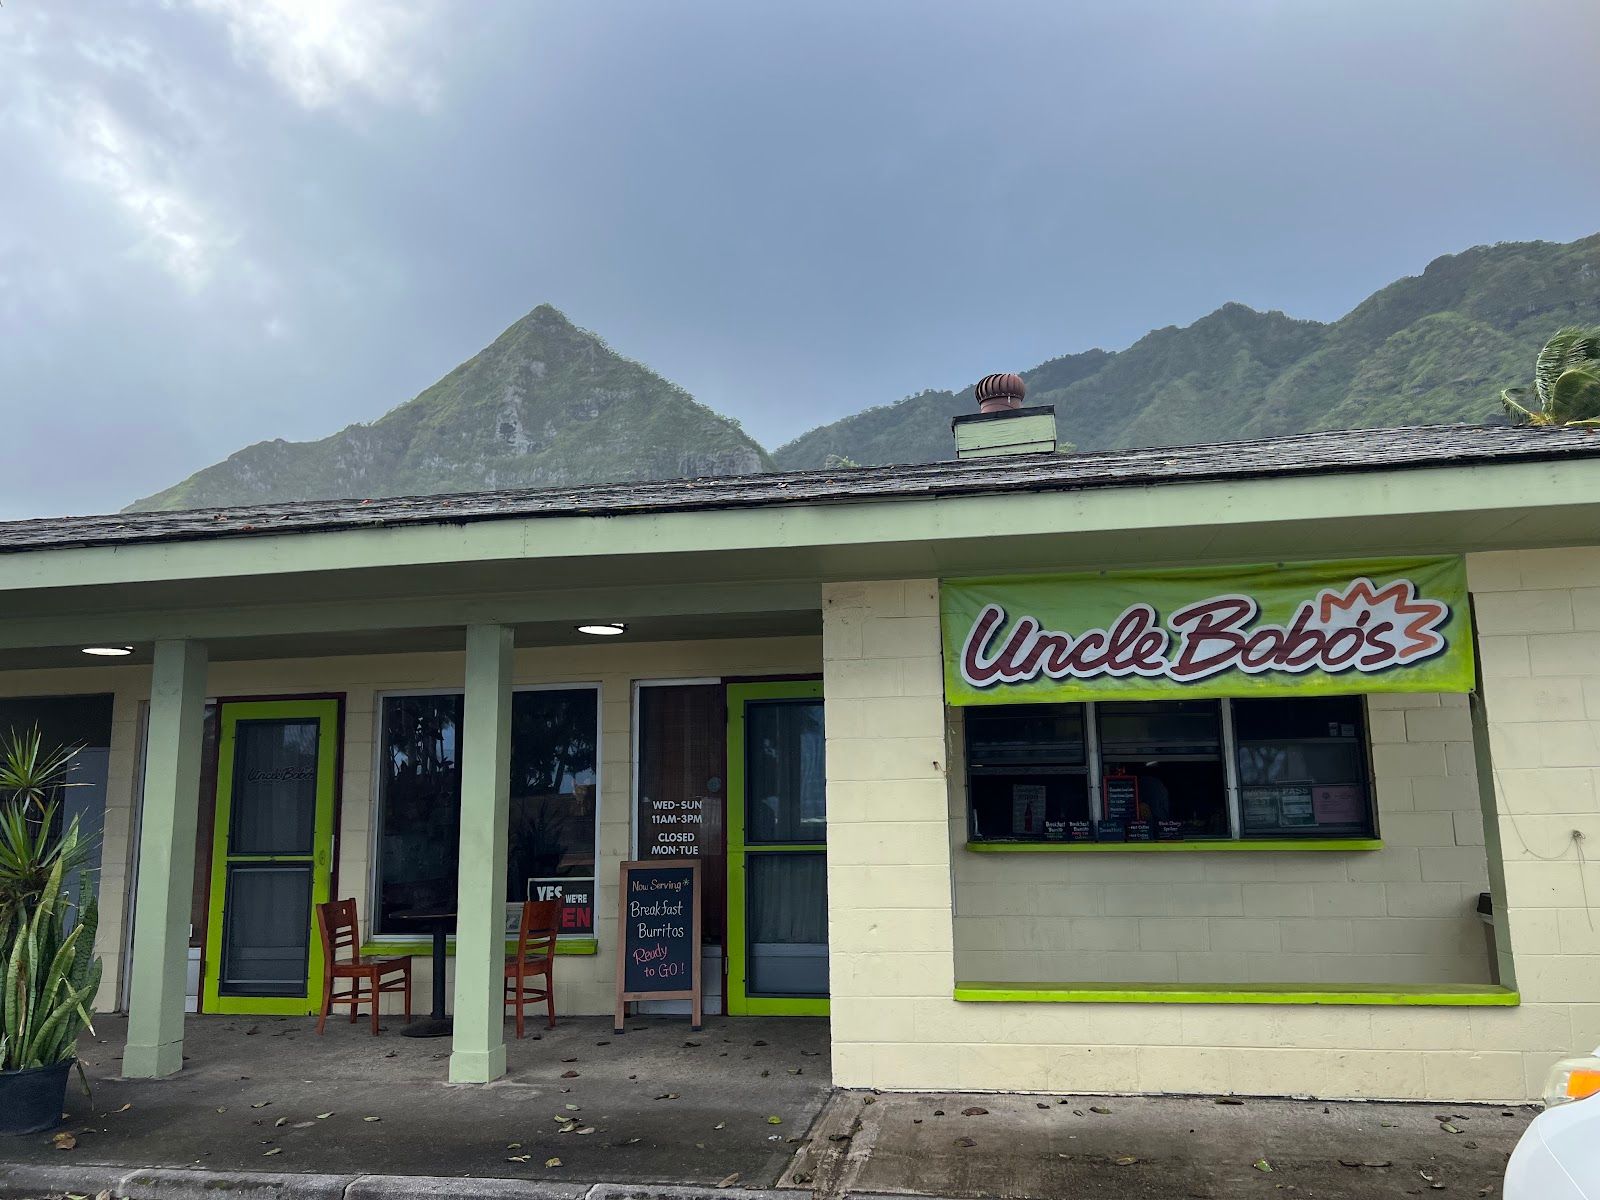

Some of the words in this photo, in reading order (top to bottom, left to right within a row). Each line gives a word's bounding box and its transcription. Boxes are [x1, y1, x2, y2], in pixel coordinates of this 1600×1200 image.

[964, 607, 1164, 681] Uncle
[1170, 597, 1395, 677] Bobo's
[652, 800, 703, 810] WED-SUN
[651, 814, 703, 824] 11AM-3PM
[657, 832, 695, 842] CLOSED
[632, 880, 649, 892] Now
[565, 893, 588, 904] WE'RE
[630, 900, 684, 917] Breakfast
[562, 907, 591, 928] EN
[637, 922, 684, 939] Burritos
[632, 942, 668, 965] Ready
[644, 966, 655, 978] to
